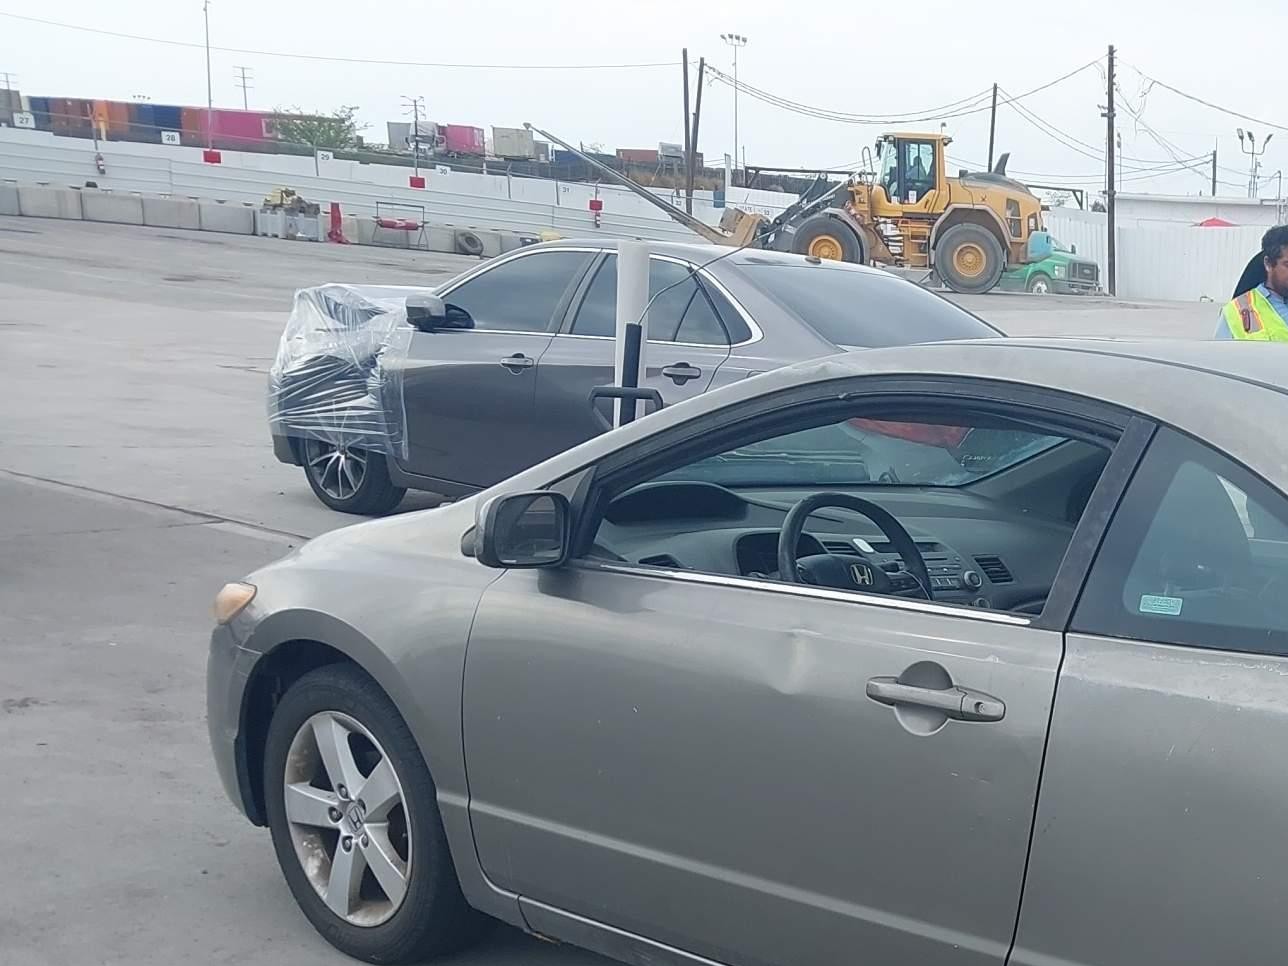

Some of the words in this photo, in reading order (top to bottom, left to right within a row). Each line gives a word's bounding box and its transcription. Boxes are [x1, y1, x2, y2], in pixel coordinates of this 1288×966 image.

[19, 117, 30, 125] 27
[165, 133, 176, 142] 28
[320, 153, 330, 161] 29
[439, 167, 448, 175] 30
